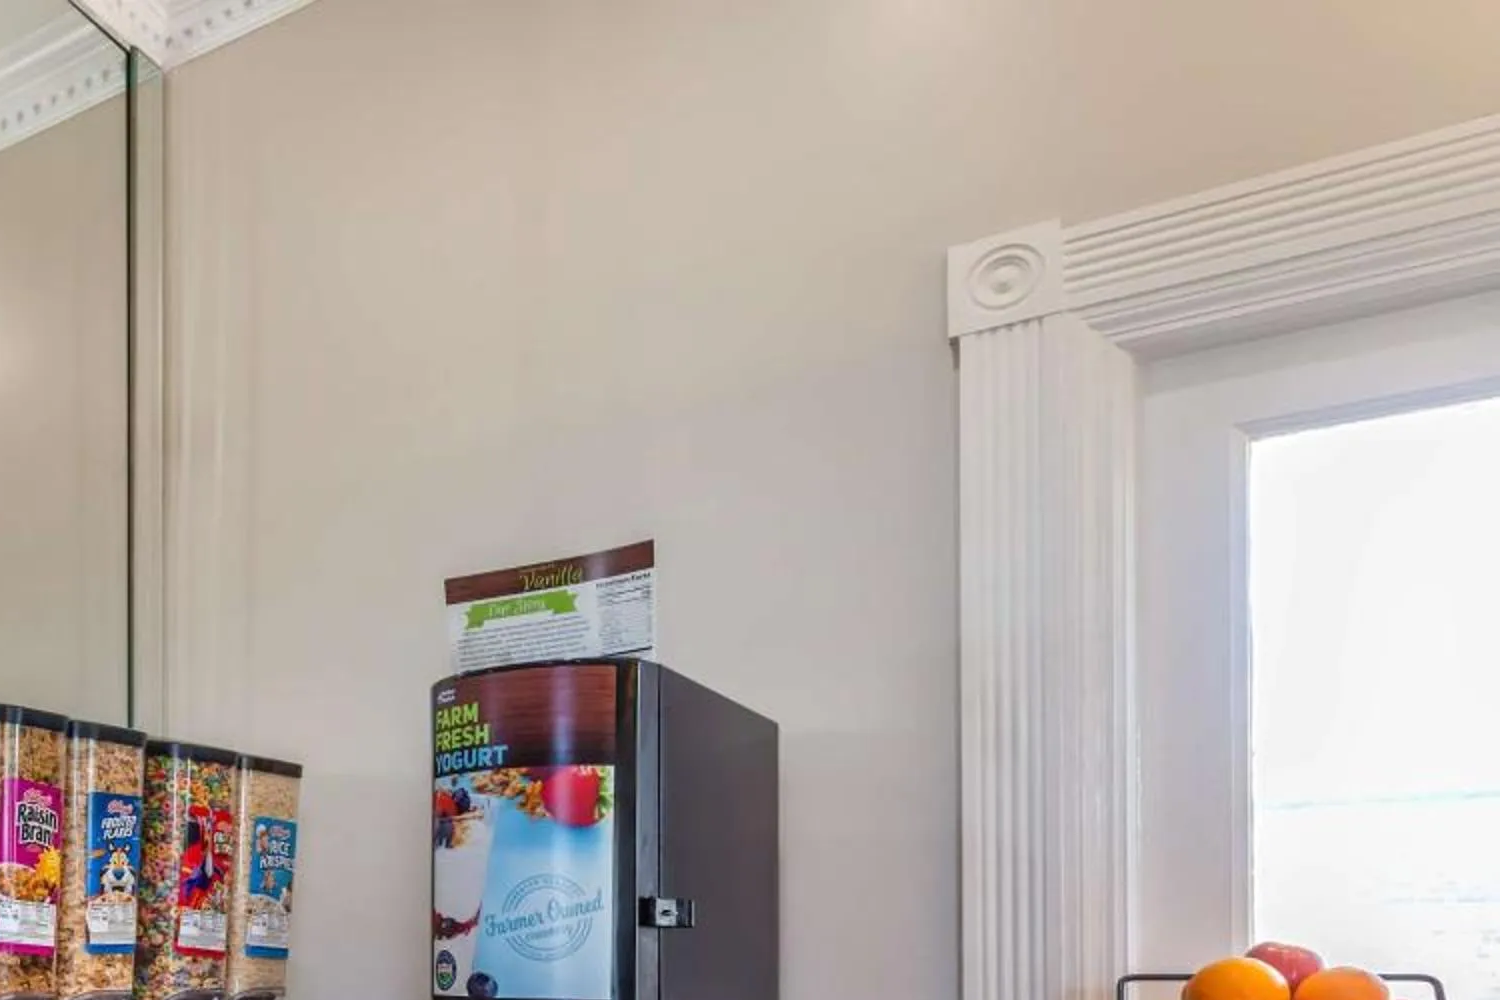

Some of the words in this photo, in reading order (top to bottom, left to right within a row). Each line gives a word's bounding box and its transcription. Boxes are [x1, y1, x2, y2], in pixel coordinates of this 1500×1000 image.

[436, 702, 479, 728] FARM
[435, 723, 491, 752] FRESH
[435, 744, 509, 777] YOGURT
[17, 803, 58, 831] Raisin
[20, 823, 52, 847] Bran
